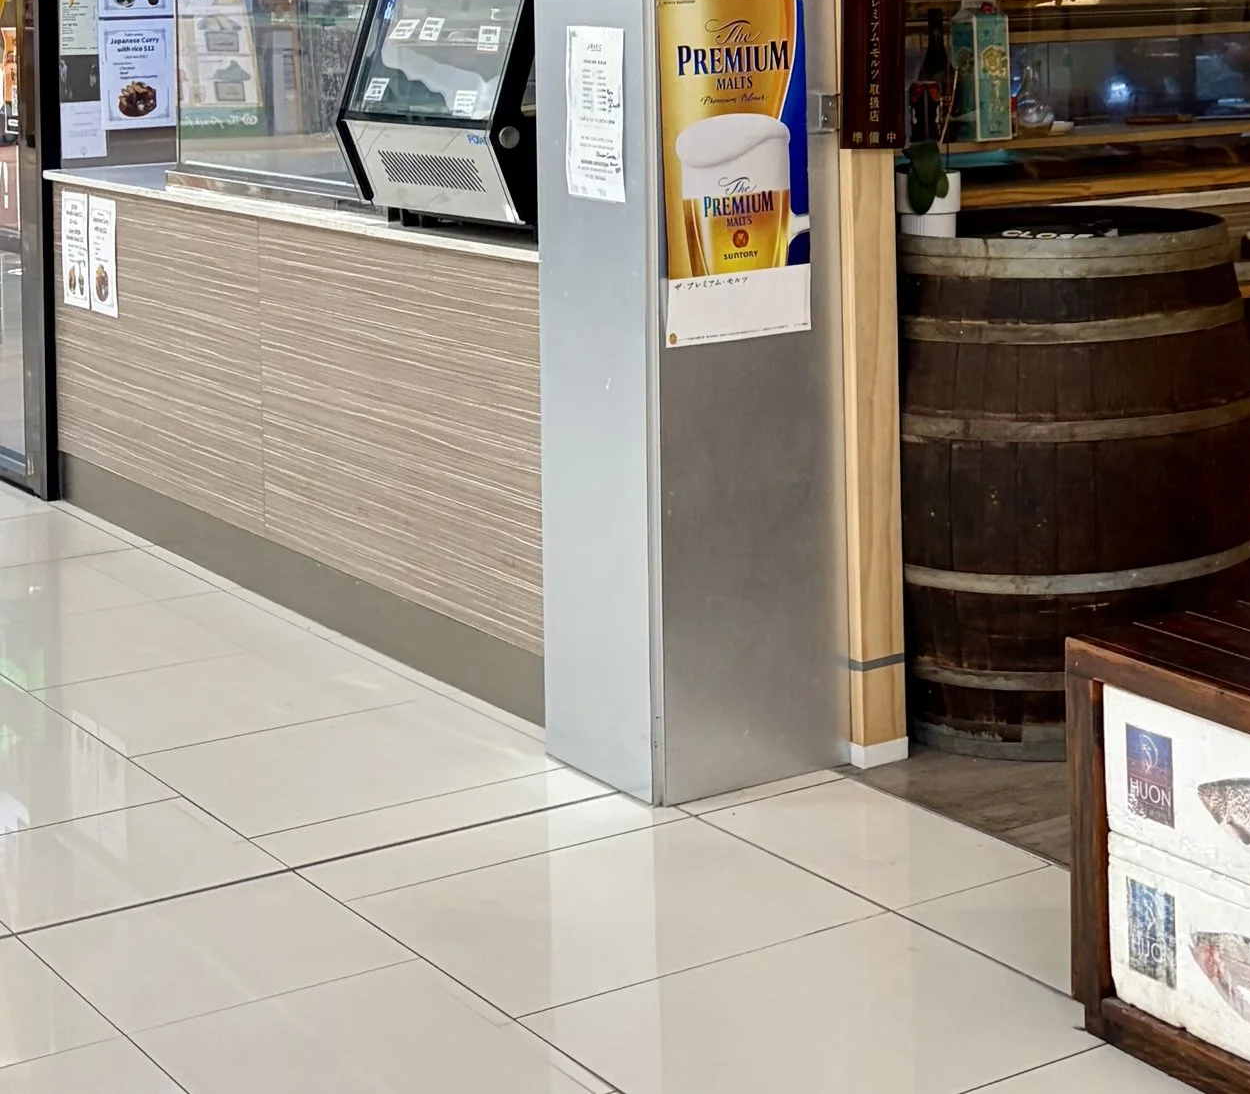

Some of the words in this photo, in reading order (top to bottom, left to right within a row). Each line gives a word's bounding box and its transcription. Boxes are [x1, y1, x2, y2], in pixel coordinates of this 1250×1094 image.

[110, 37, 140, 46] Japanese
[141, 36, 160, 45] Curry
[704, 19, 761, 46] The
[143, 45, 155, 53] $12
[676, 39, 791, 77] PREMIUM
[716, 74, 753, 91] MALT'S
[718, 176, 757, 196] The
[703, 190, 774, 218] PREMIUM
[726, 214, 753, 227] MALT'S
[723, 249, 759, 261] SUNTORY
[1130, 776, 1172, 808] HUON
[1131, 933, 1177, 970] HUON
